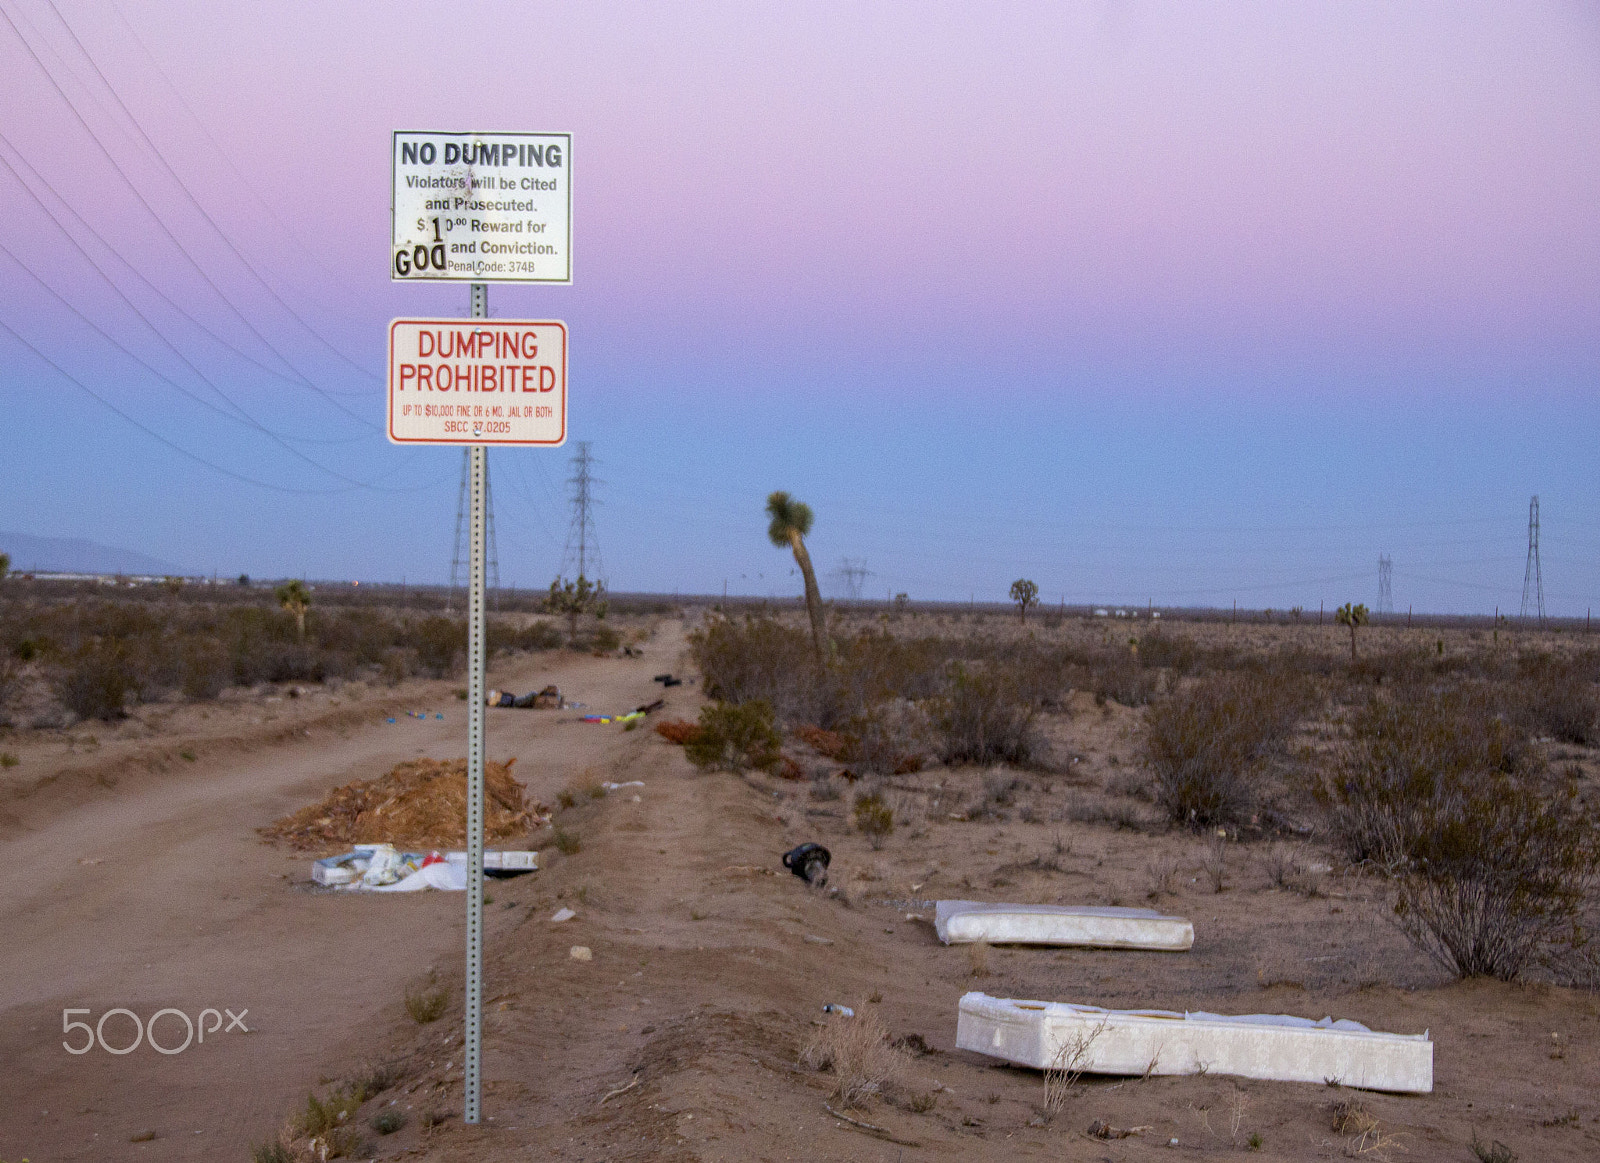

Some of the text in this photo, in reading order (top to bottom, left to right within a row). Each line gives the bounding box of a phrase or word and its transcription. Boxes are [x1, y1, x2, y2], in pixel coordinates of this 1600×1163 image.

[402, 142, 562, 167] NO DUMPING
[406, 175, 557, 190] Violators will be Cited
[425, 198, 537, 211] and Prosecuted.
[471, 219, 523, 232] Reward
[528, 221, 546, 233] for
[451, 241, 558, 255] and Conviction.
[448, 260, 535, 272] Penal Code: 374B
[419, 331, 538, 359] DUMPING
[400, 364, 556, 392] PROHIBITED
[403, 405, 552, 418] UP TO $10,000 FINE OR 6 MO. JAIL OR BOTH
[444, 421, 510, 433] SBCC 37.0205
